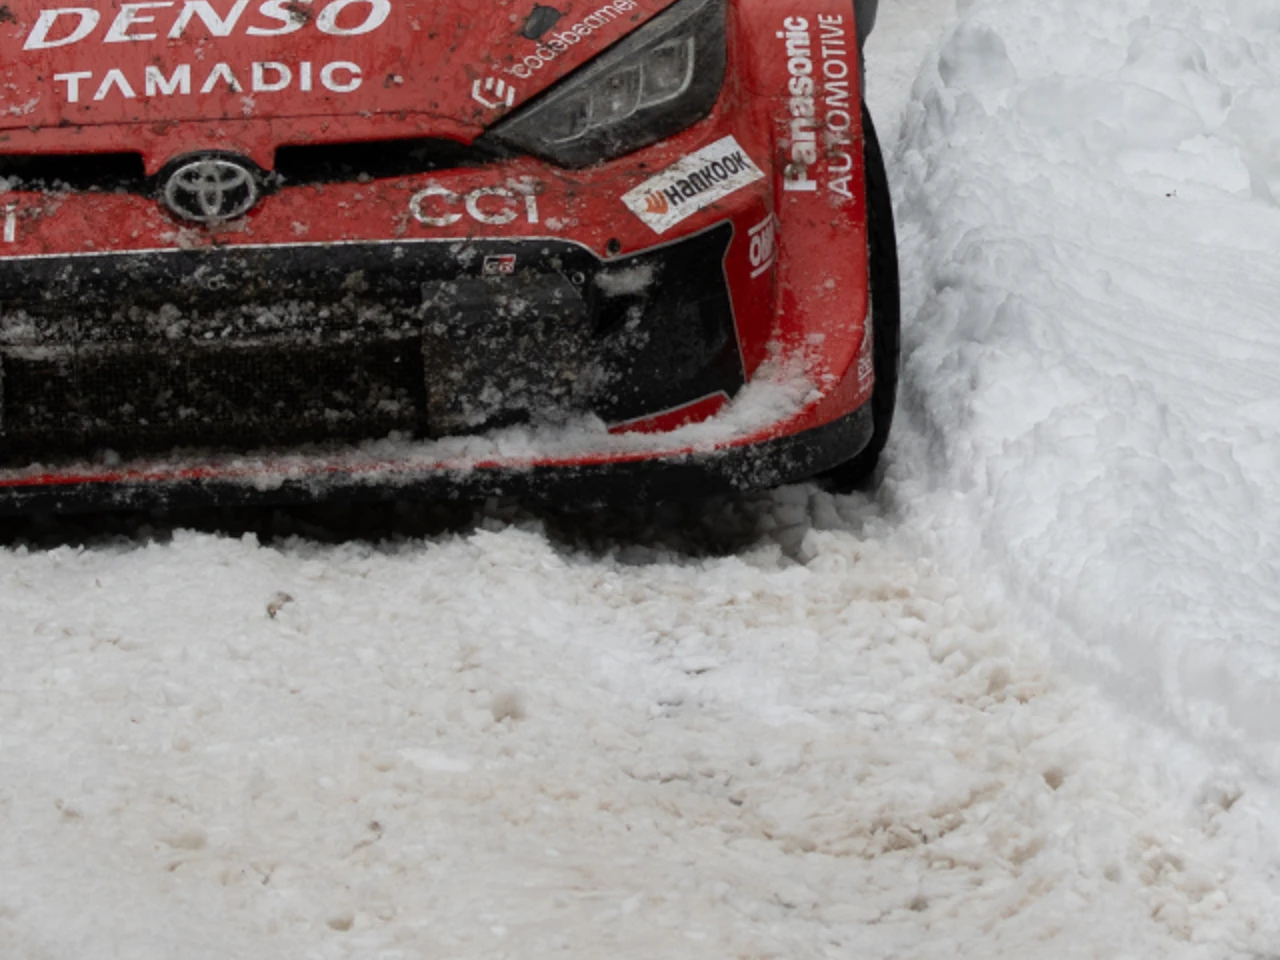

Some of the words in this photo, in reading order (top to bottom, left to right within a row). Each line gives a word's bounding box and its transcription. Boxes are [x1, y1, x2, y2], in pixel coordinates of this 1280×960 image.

[53, 61, 363, 104] TAMADIC
[776, 15, 817, 192] Panasonic
[818, 14, 853, 198] AUTOMOTIVE
